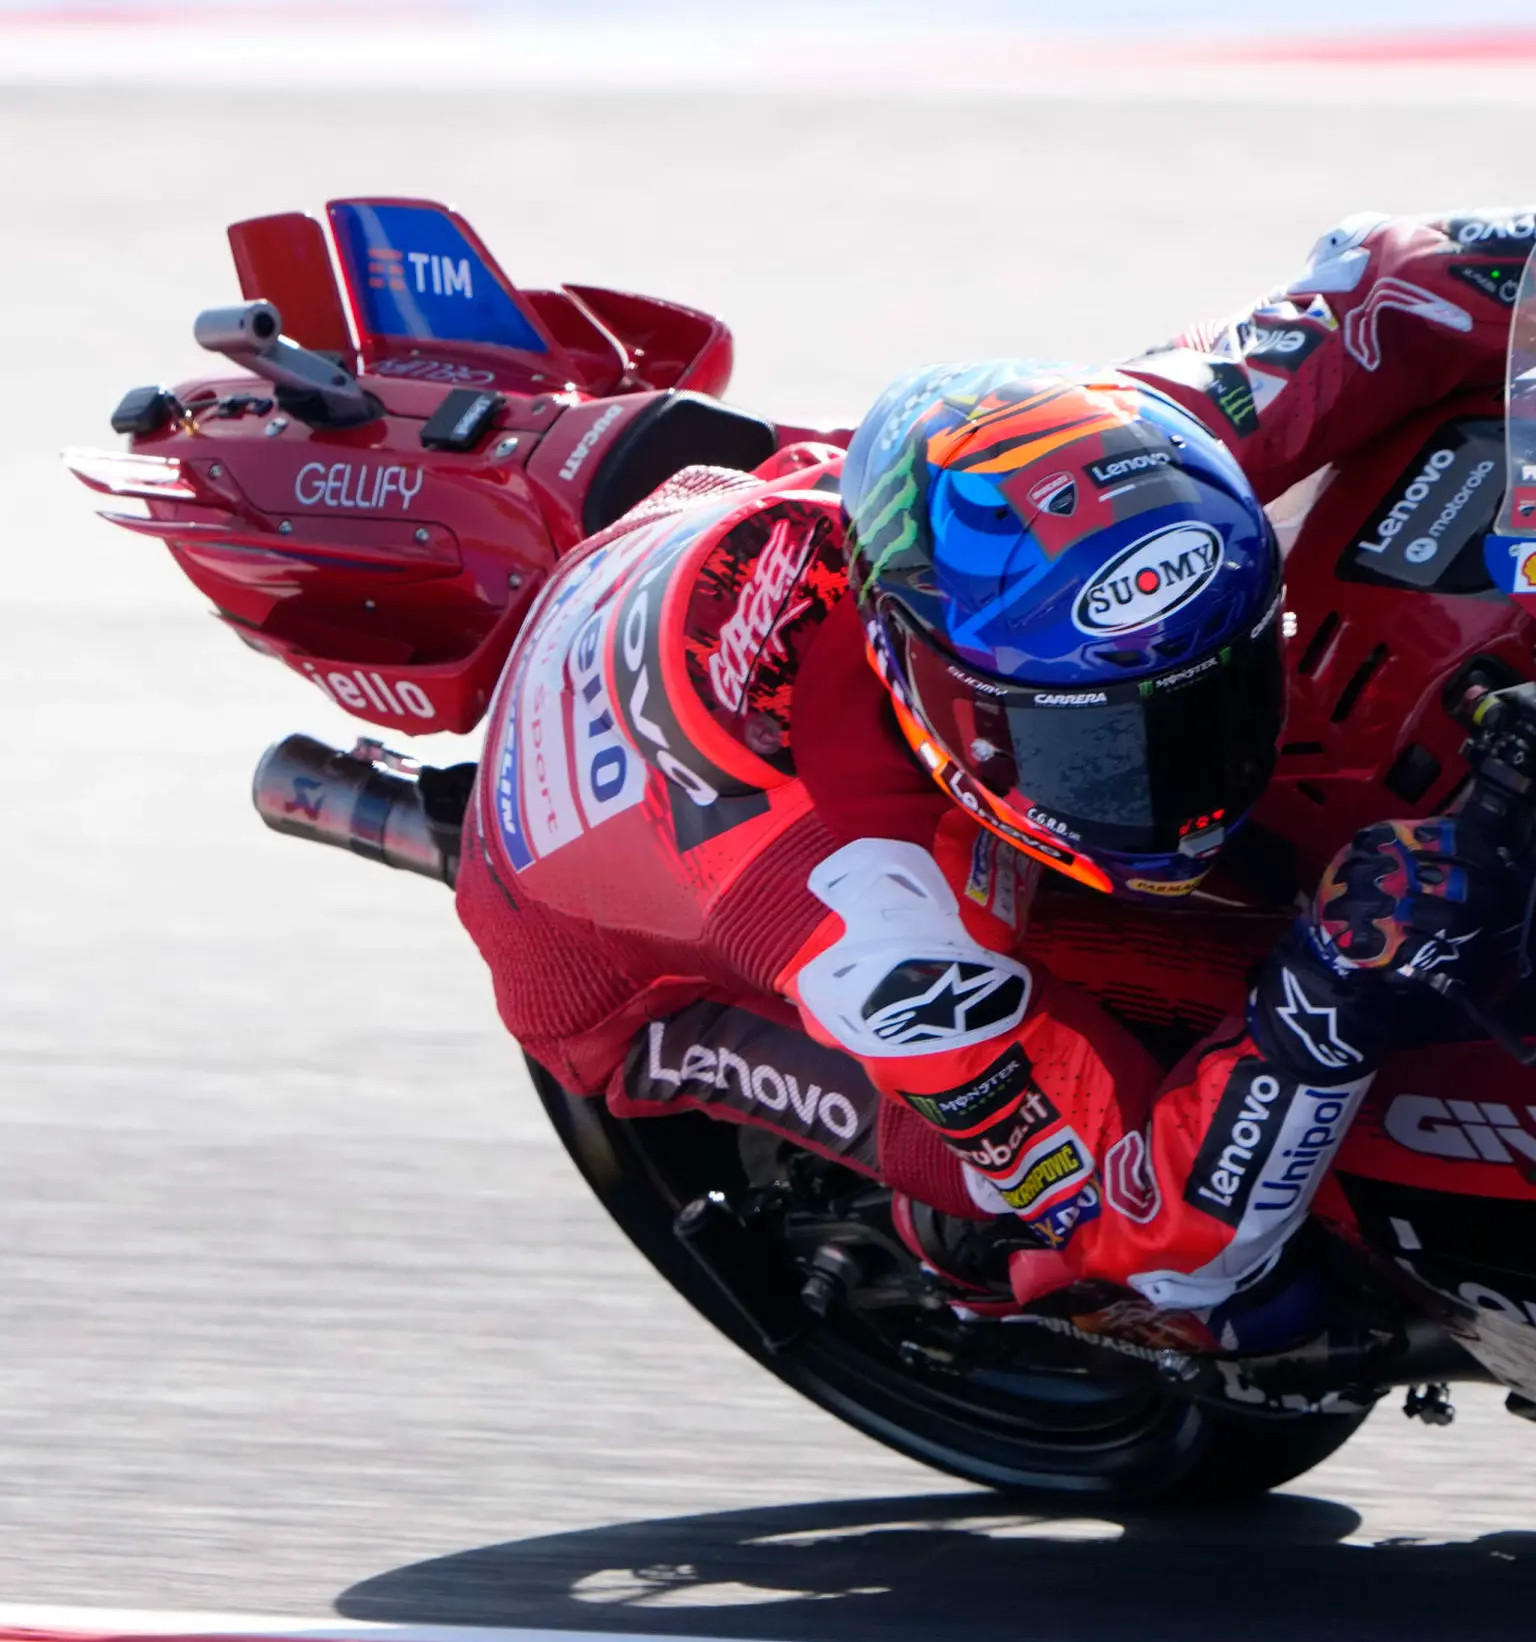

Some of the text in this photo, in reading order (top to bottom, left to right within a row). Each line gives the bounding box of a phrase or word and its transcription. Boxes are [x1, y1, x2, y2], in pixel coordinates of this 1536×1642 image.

[408, 252, 473, 299] TIM
[558, 403, 624, 481] DUCATI
[1091, 451, 1172, 481] Lenovo
[294, 461, 424, 511] GELLIFY
[1358, 448, 1456, 555] Lenovo
[1428, 459, 1495, 537] motorola
[1086, 542, 1216, 615] SUOMY
[302, 661, 436, 719] iello
[1033, 691, 1108, 708] CARRERA
[648, 1021, 859, 1140] Lenovo
[957, 1090, 1049, 1168] uba.it
[1198, 1073, 1281, 1208] Lenovo
[1253, 1087, 1351, 1213] Unipol
